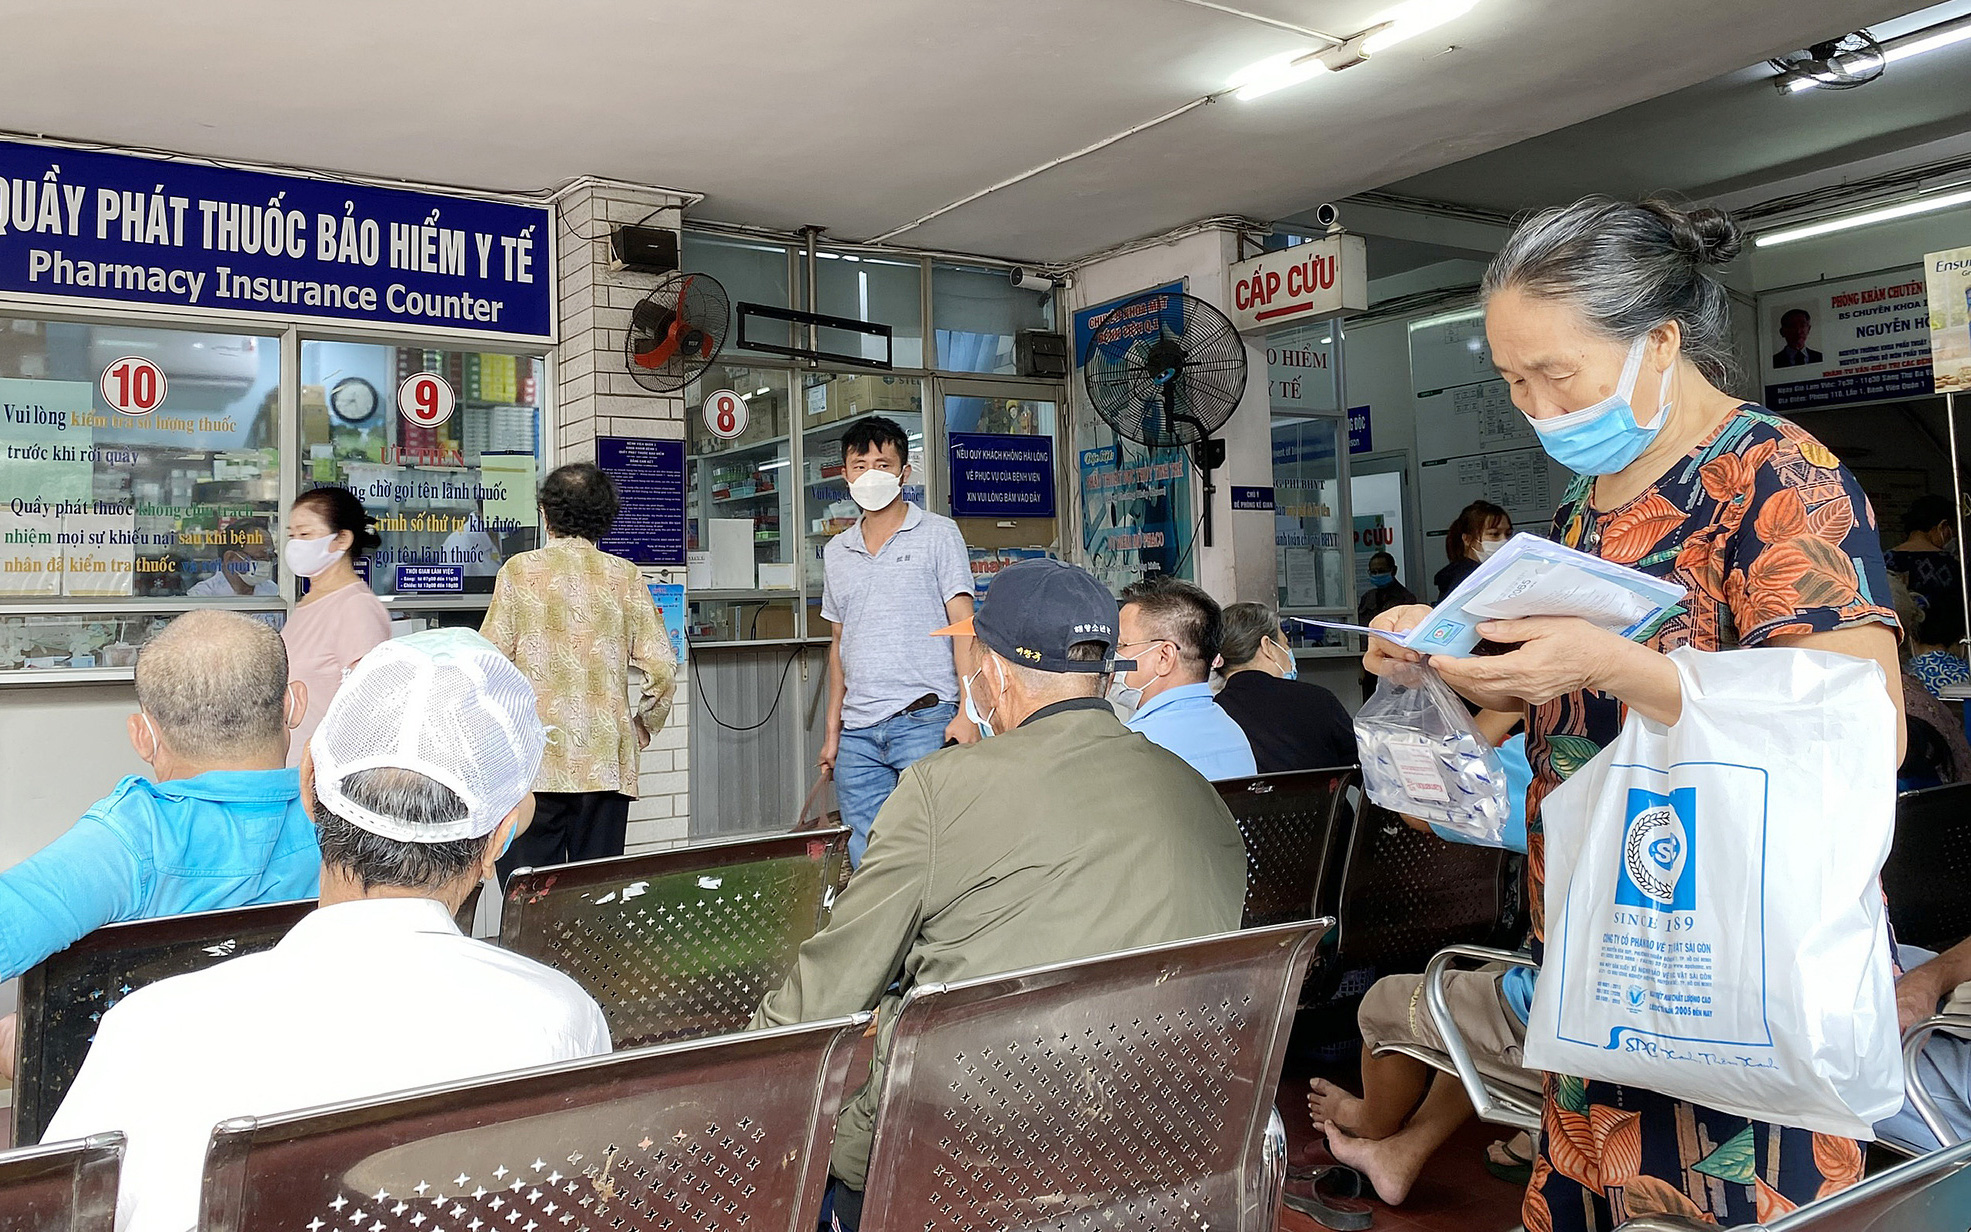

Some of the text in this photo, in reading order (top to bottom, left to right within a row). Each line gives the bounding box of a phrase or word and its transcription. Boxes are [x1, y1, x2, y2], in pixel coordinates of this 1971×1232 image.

[97, 184, 189, 247] PHÁT
[199, 191, 306, 259] THUỐC
[317, 200, 380, 267] BẢO
[390, 208, 466, 276] HIỂM
[475, 232, 493, 279] Y
[501, 225, 536, 284] TẾ
[29, 249, 503, 322] Pharmacy Insurance Counter
[1235, 253, 1335, 311] CẤP CỨU
[1838, 300, 1922, 321] BS CHUYÊN KHOA
[1856, 316, 1911, 339] NGUYỄN
[1282, 342, 1328, 370] HIỂM
[112, 364, 157, 409] 10
[1280, 375, 1302, 400] TẾ
[415, 380, 440, 420] 9
[4, 404, 237, 433] Vui lòng kiểm tra số lượng thuốc
[716, 396, 736, 432] 8
[8, 443, 140, 467] trước khi rời quầy
[380, 443, 465, 467] ƯU TIÊN
[956, 446, 969, 460] NẾU
[969, 447, 982, 460] QUÝ
[983, 448, 1003, 461] KHÁCH
[1003, 448, 1023, 462] KHÔNG
[1034, 449, 1049, 462] LÒNG
[965, 468, 1041, 484] VỀ PHỤC VỤ CỦA BỆNH VIỆN
[1301, 480, 1326, 491] BHYT
[370, 479, 507, 503] chờ gọi tên lãnh thuốc
[966, 490, 1041, 503] XIN VUI LÒNG BẤM VÀO ĐÂY
[11, 495, 51, 518] Quầy
[55, 498, 88, 518] phát
[93, 498, 133, 516] thuốc
[138, 501, 181, 520] không
[410, 510, 427, 533] số
[427, 513, 449, 533] thứ
[452, 515, 467, 535] tự
[470, 514, 490, 533] khi
[492, 515, 522, 533] được
[5, 526, 264, 549] nhiệm mọi sự khiếu nại sau khi bệnh
[1362, 522, 1394, 548] CỨU
[4, 557, 42, 573] nhân
[47, 556, 65, 573] đã
[70, 553, 107, 573] kiểm
[111, 558, 132, 573] tra
[136, 554, 176, 573] thuốc
[375, 543, 484, 568] gọi tên lãnh thuốc
[1613, 911, 1658, 930] SINCE
[1675, 1005, 1692, 1016] 2005
